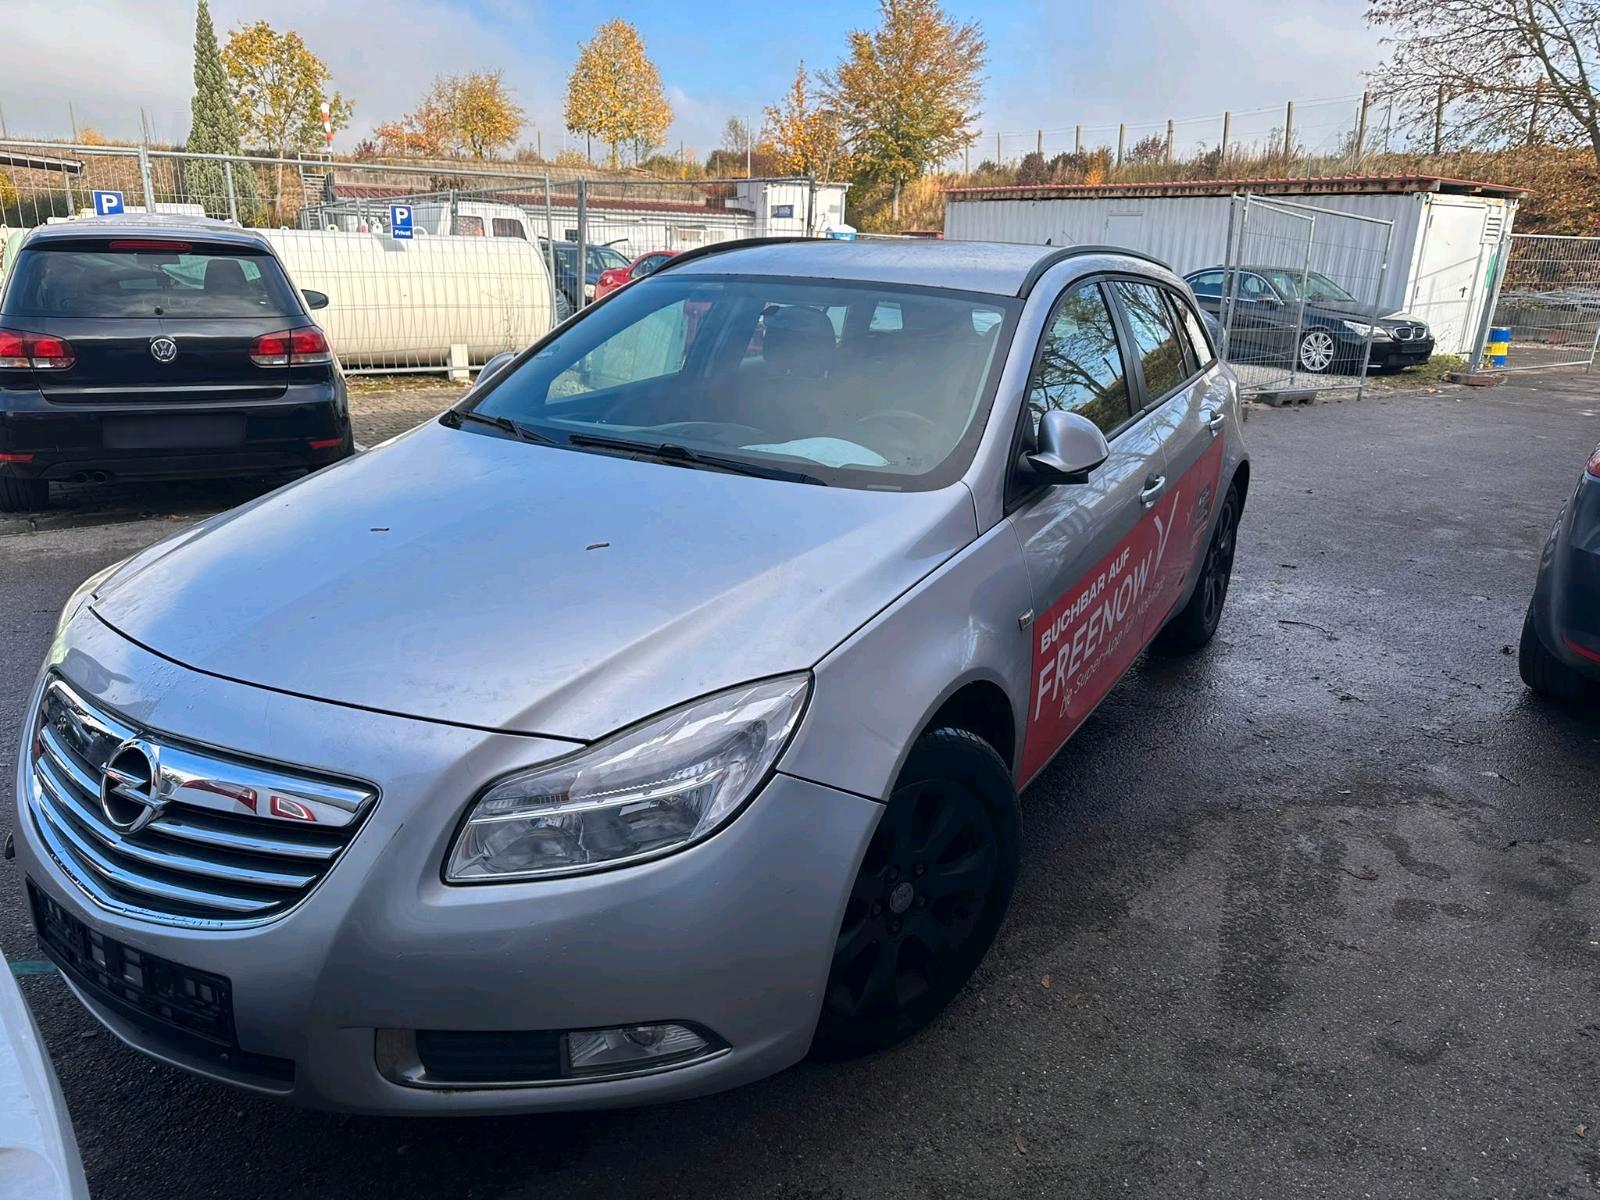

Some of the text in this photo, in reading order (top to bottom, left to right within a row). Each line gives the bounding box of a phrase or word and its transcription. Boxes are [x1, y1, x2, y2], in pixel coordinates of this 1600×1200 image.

[101, 194, 118, 214] P
[395, 207, 409, 225] P
[1040, 546, 1130, 655] BUCHBAR AUF
[1034, 549, 1153, 722] FREENOW
